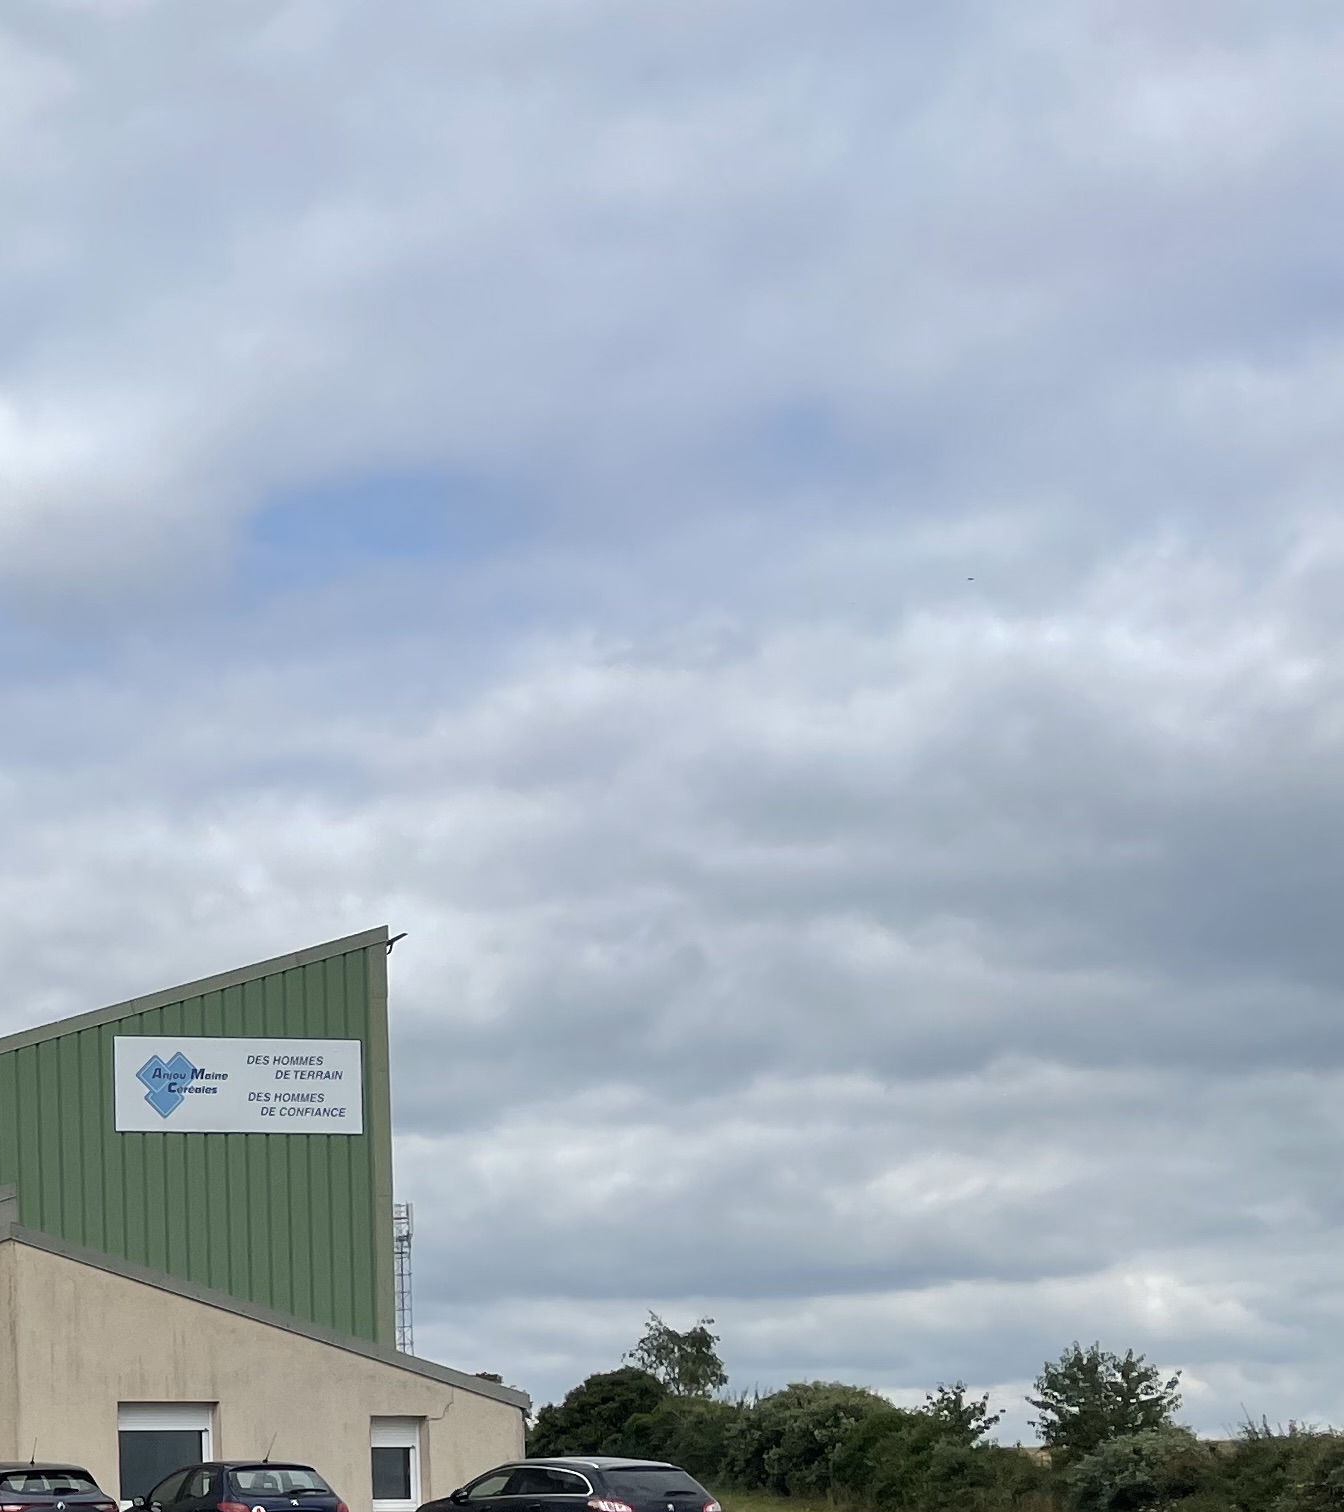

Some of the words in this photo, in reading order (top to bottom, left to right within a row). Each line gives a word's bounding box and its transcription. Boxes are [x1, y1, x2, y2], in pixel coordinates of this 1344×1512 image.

[247, 1055, 270, 1065] DES
[273, 1055, 324, 1066] HOMMES
[152, 1068, 186, 1080] Anjou
[191, 1068, 228, 1080] Maine
[275, 1070, 291, 1079] DE
[294, 1070, 343, 1080] TERRAIN
[248, 1092, 271, 1102] DES
[273, 1093, 325, 1103] HOMMES
[260, 1106, 276, 1116] DE
[279, 1107, 346, 1117] CONFIANCE
